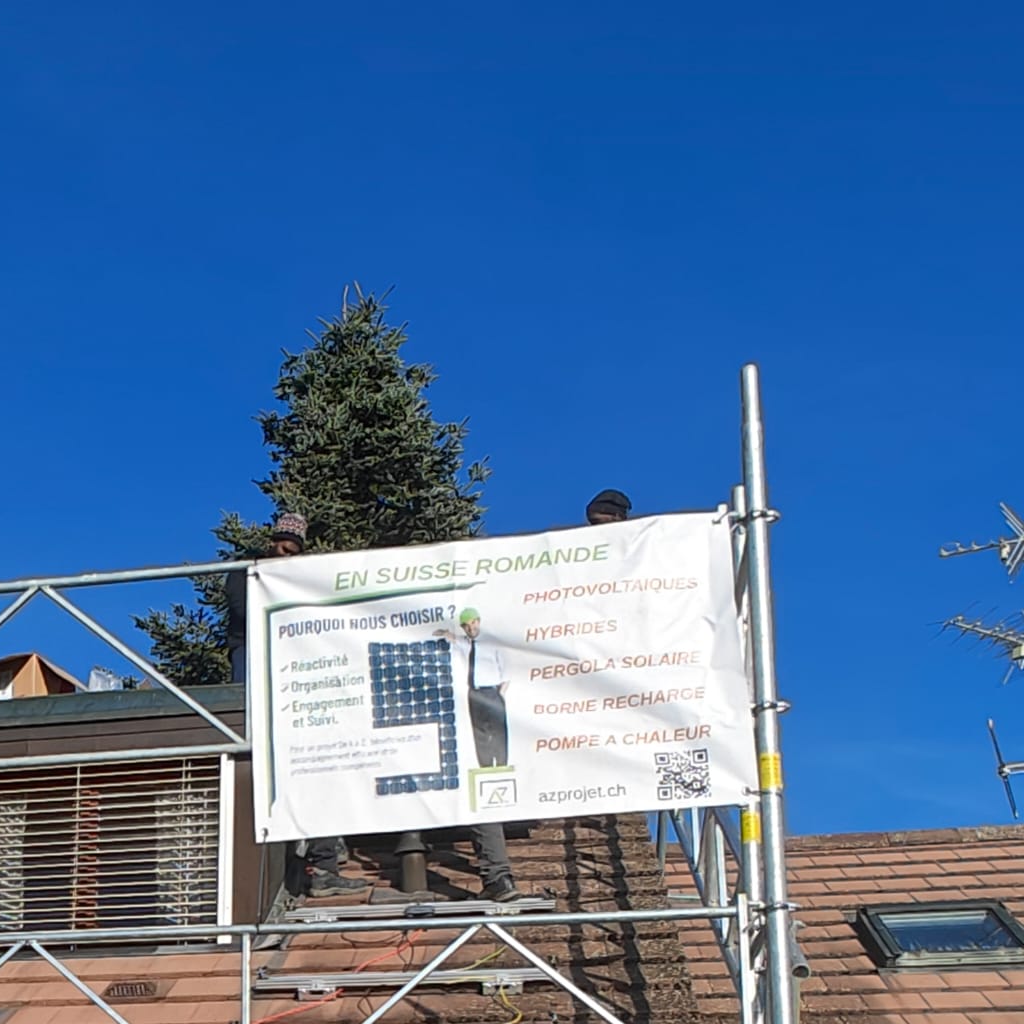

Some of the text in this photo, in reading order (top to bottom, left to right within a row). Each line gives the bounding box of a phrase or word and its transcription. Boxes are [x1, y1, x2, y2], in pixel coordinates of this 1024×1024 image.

[334, 543, 610, 591] EN SUISSE ROMANDE
[523, 577, 699, 605] PHOTOVOLTAIQUES
[279, 618, 345, 639] POURQUOI
[349, 616, 387, 631] NOUS
[390, 607, 445, 628] CHOISIR
[526, 620, 618, 643] HYBRIDES
[291, 654, 349, 672] Réactivité
[530, 651, 702, 681] PERGOLA SOLAIRE
[291, 675, 365, 694] Organisation
[292, 695, 365, 714] Engagement
[534, 687, 706, 715] BORNE RECHARGE
[293, 713, 339, 729] et Suivi.
[536, 735, 601, 752] POMPE
[622, 725, 712, 745] CHALEUR
[538, 784, 626, 804] azprojet.ch
